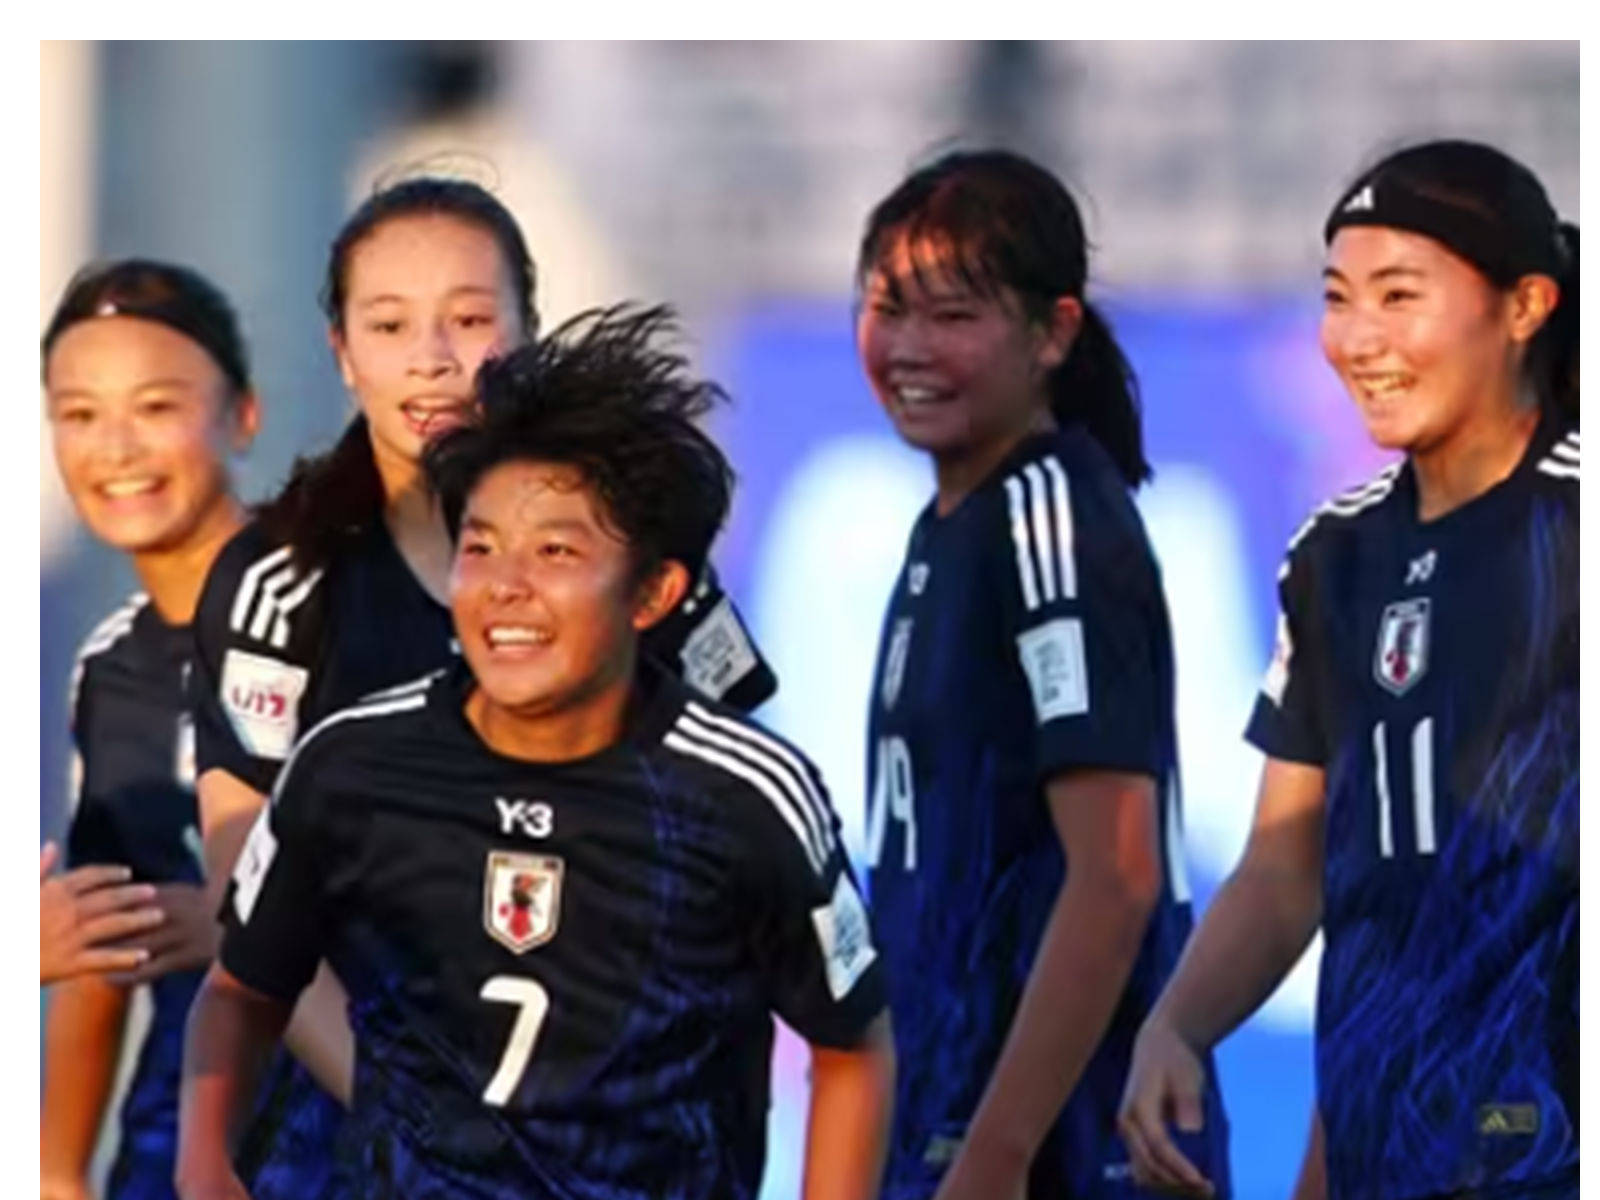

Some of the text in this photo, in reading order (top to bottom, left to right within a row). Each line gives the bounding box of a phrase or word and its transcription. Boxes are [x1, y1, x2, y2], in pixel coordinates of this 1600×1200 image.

[496, 797, 553, 839] Y-3
[1373, 717, 1437, 858] 11
[480, 975, 549, 1107] 7
